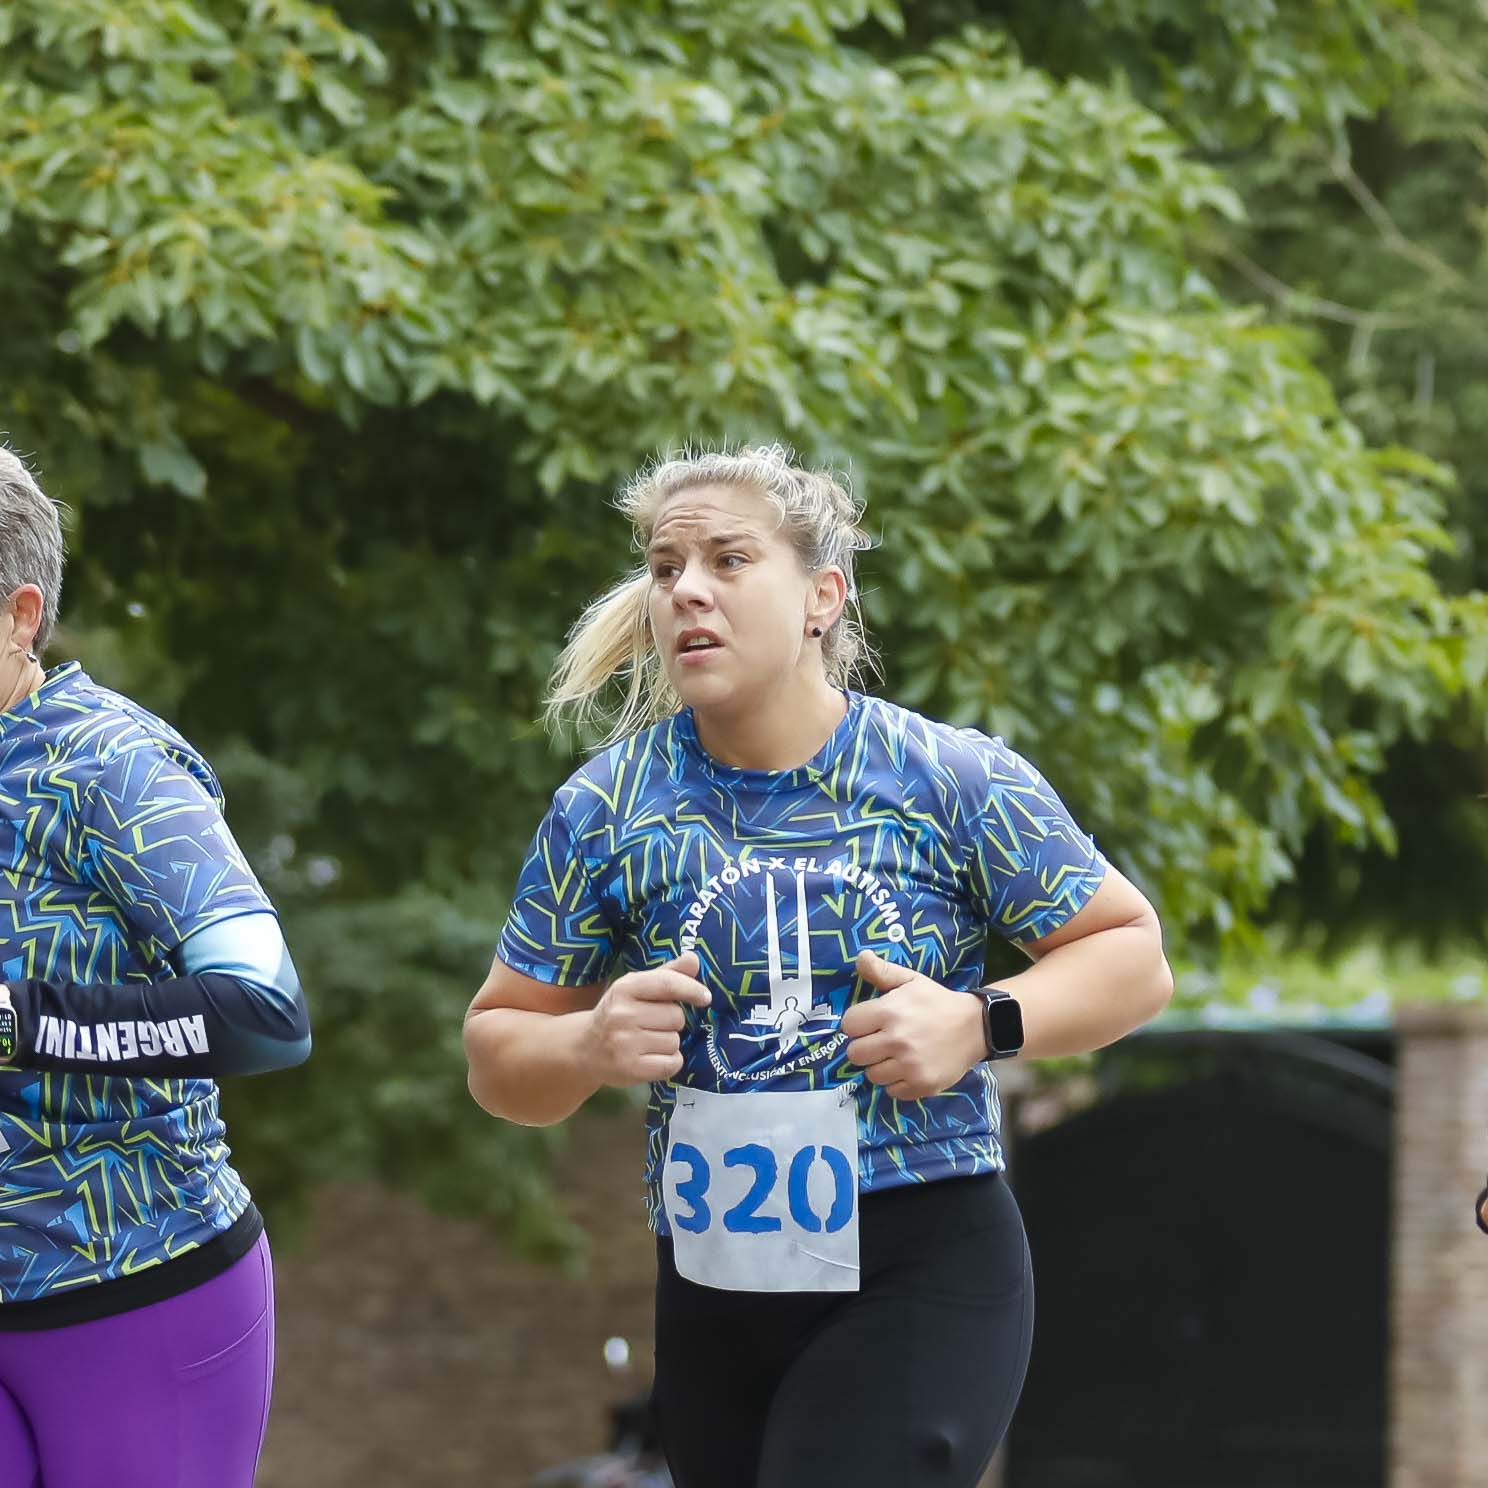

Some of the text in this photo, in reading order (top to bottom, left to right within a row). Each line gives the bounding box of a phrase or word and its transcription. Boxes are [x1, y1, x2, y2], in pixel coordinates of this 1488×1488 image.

[768, 856, 786, 871] X
[793, 857, 819, 873] EL
[823, 860, 906, 943] AUTISMO
[670, 1142, 854, 1235] 320
